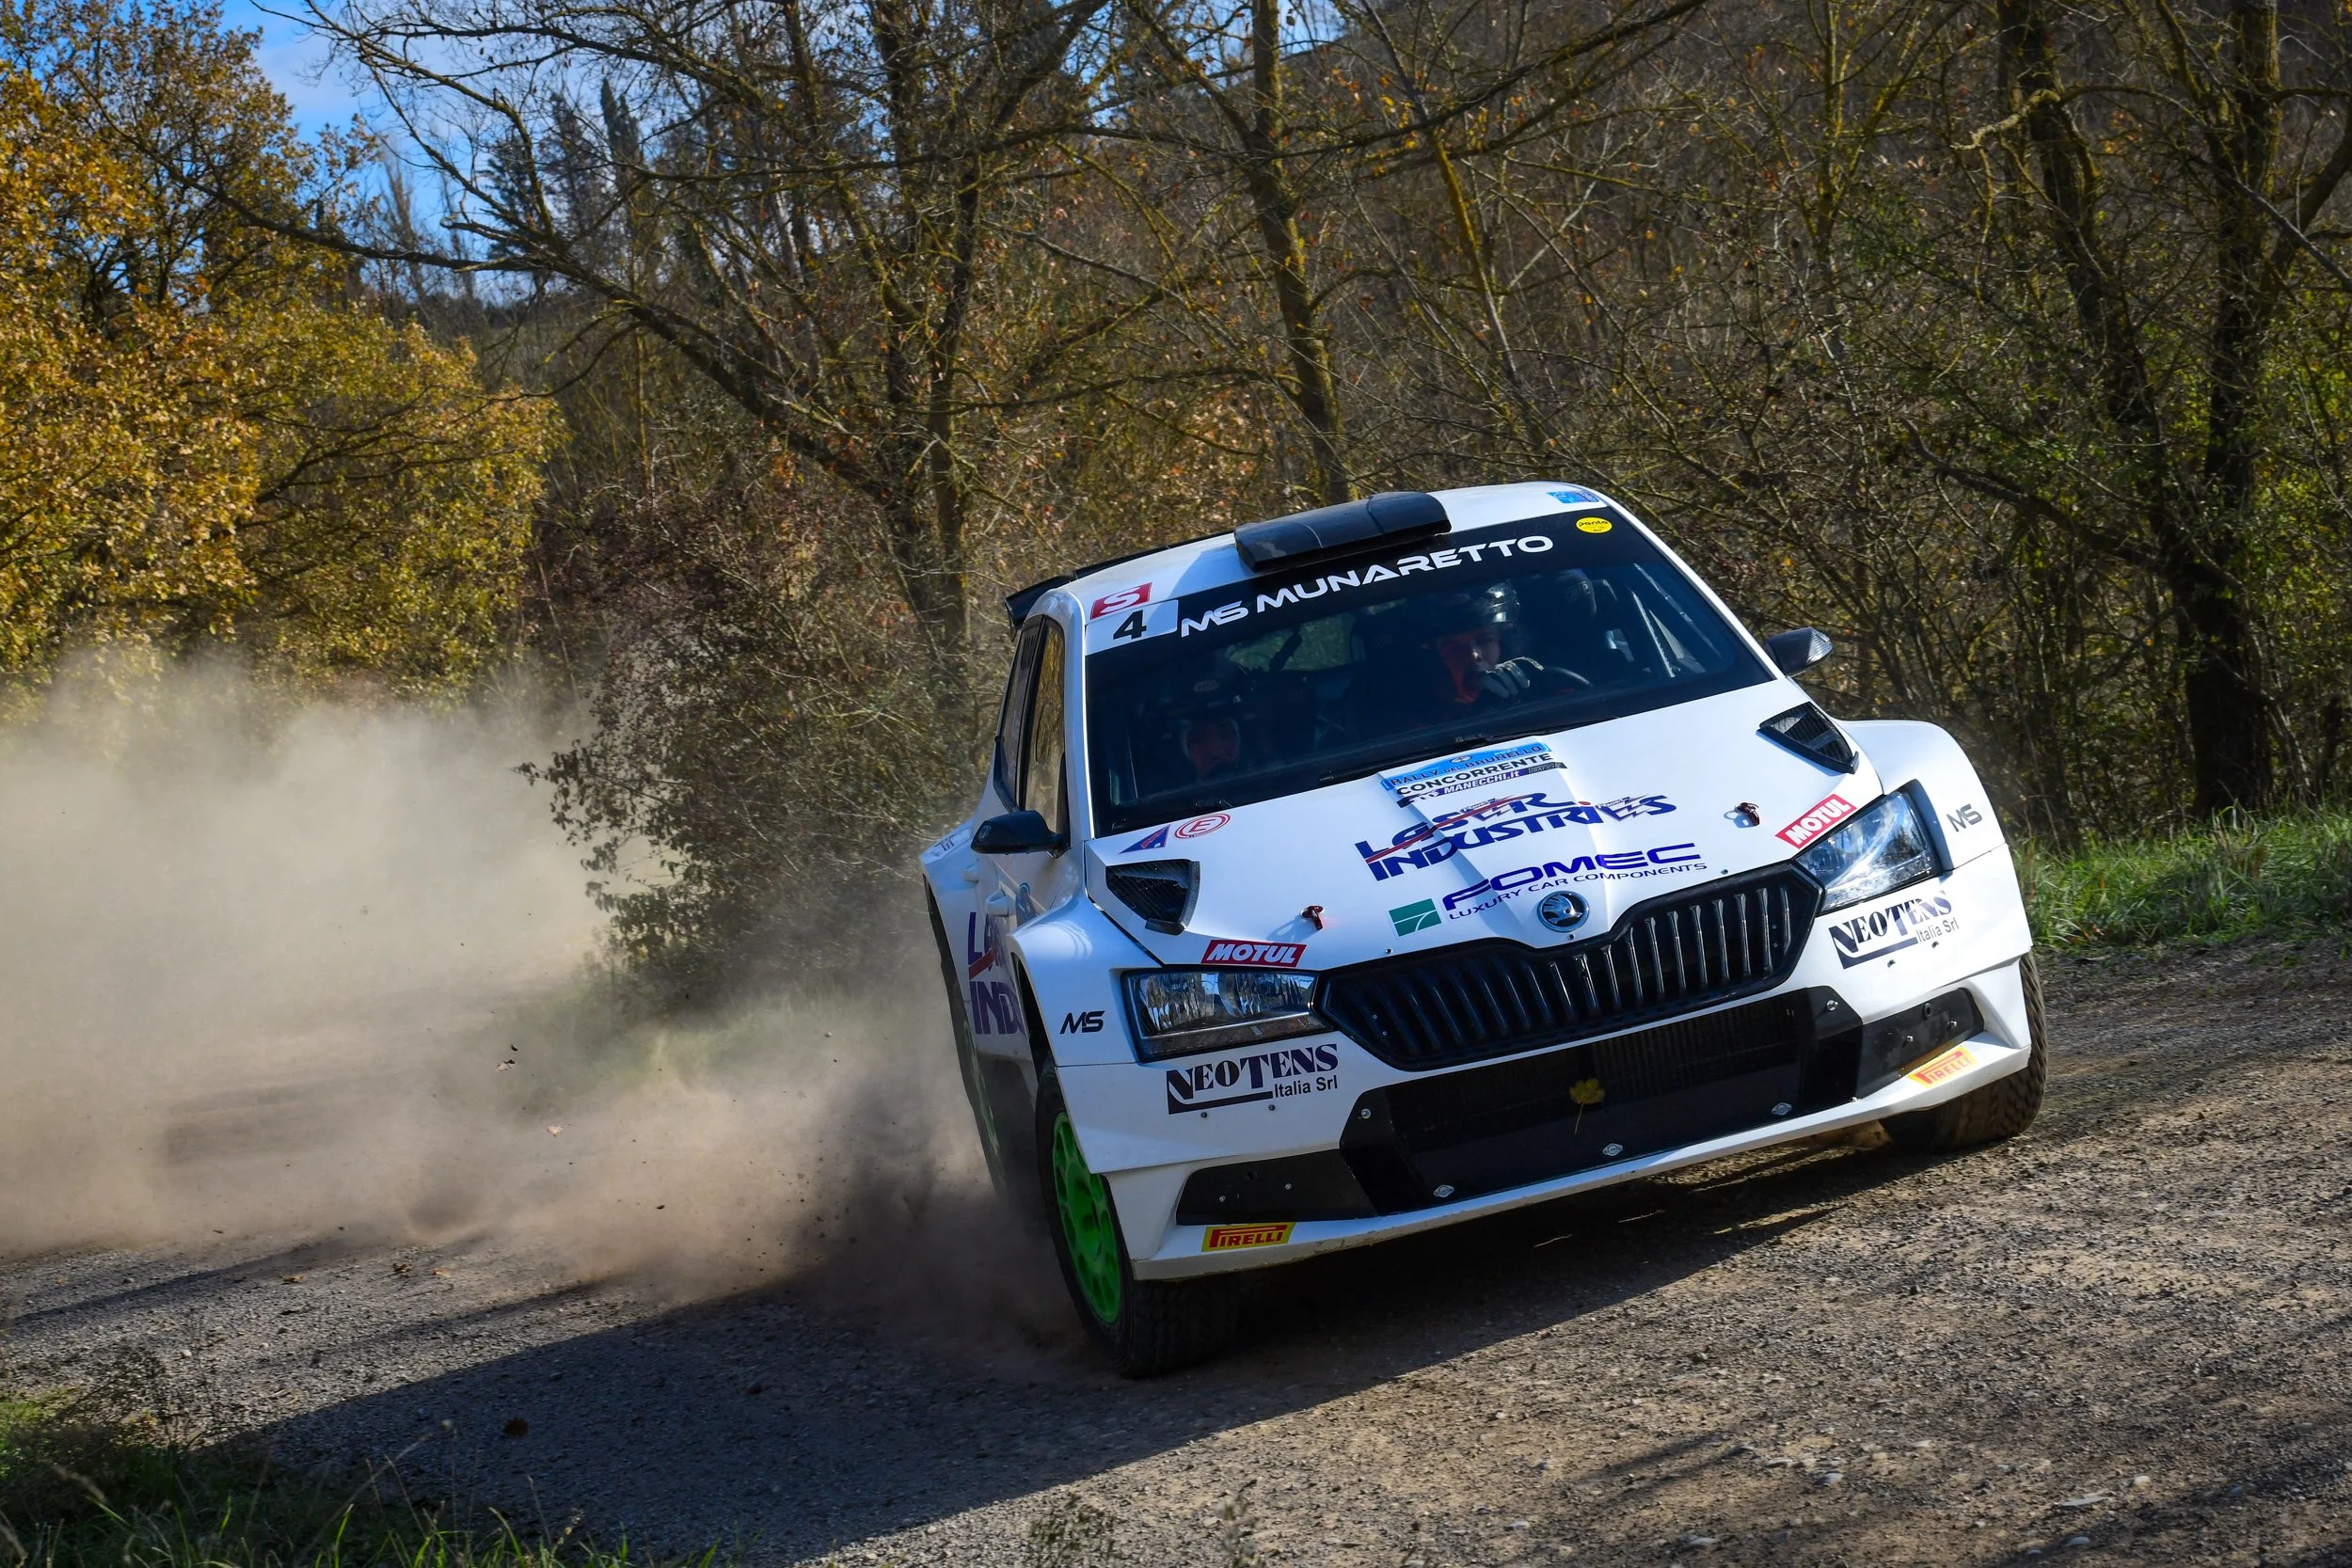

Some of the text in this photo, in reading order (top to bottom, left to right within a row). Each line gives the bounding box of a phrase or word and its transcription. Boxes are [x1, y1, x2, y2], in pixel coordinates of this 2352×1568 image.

[1182, 535, 1554, 638] MS MUNARETTO
[1113, 610, 1147, 640] 4
[1391, 768, 1439, 786] RALLY
[1465, 745, 1542, 768] BRUNELLO
[1397, 752, 1554, 796] CONCORRENTE
[1443, 770, 1520, 795] MANECCHI.it
[1785, 799, 1851, 846] MOTUL
[1947, 803, 1982, 832] MS
[1442, 843, 1701, 911] FOMEC
[1449, 863, 1708, 920] LUXURY CAR COMPONENTS
[1828, 890, 1952, 955] NEOTENS
[1917, 916, 1960, 943] Italia Srl
[1206, 943, 1296, 964] MOTUL
[1059, 1010, 1105, 1035] MS
[1166, 1043, 1339, 1101] NEOTENS
[1915, 1050, 1972, 1085] PIRELLI
[1274, 1074, 1338, 1098] Italia Srl
[1209, 1224, 1288, 1248] PIRELLI
